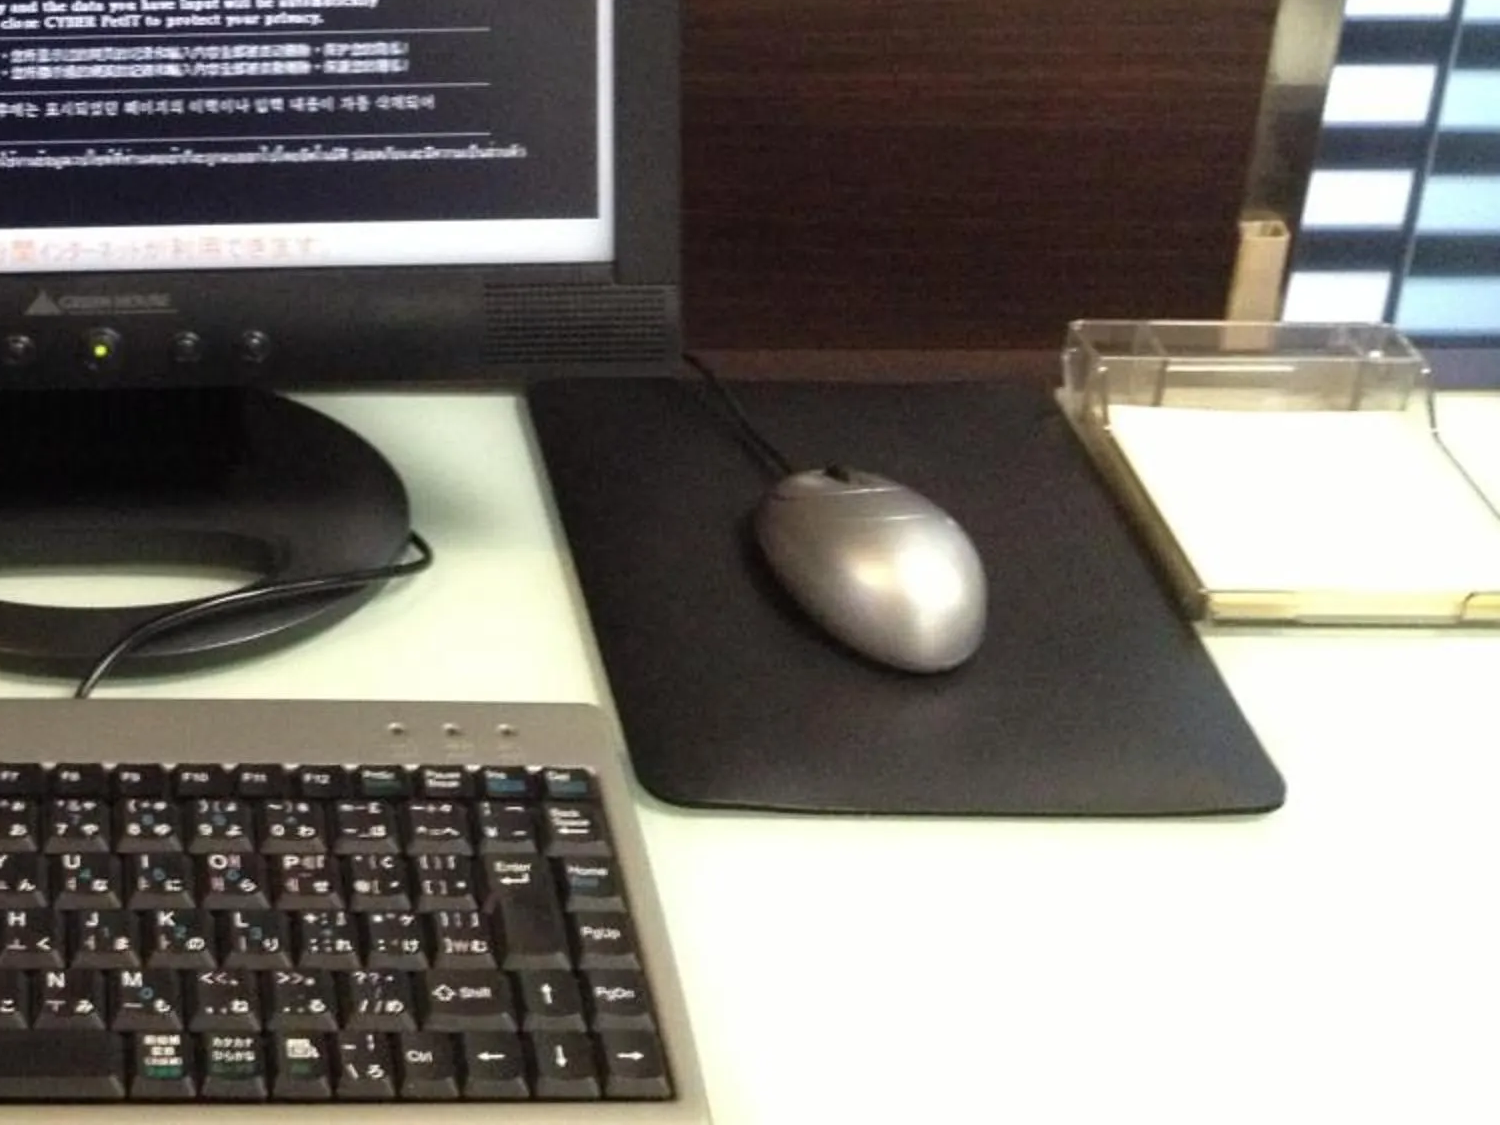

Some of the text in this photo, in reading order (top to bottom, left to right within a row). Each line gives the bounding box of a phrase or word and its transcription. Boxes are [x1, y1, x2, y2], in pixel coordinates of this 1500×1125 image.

[56, 822, 69, 835] 7
[198, 823, 213, 836] 9
[270, 823, 285, 837] 0
[63, 854, 81, 870] U
[141, 854, 149, 869] I
[207, 855, 229, 870] O
[283, 854, 301, 870] P
[7, 911, 26, 927] H
[85, 912, 99, 927] J
[158, 911, 176, 927] K
[233, 911, 249, 928] L
[47, 972, 66, 988] N
[121, 970, 143, 988] M
[459, 986, 492, 999] Shift
[405, 1049, 433, 1063] Ctrl
